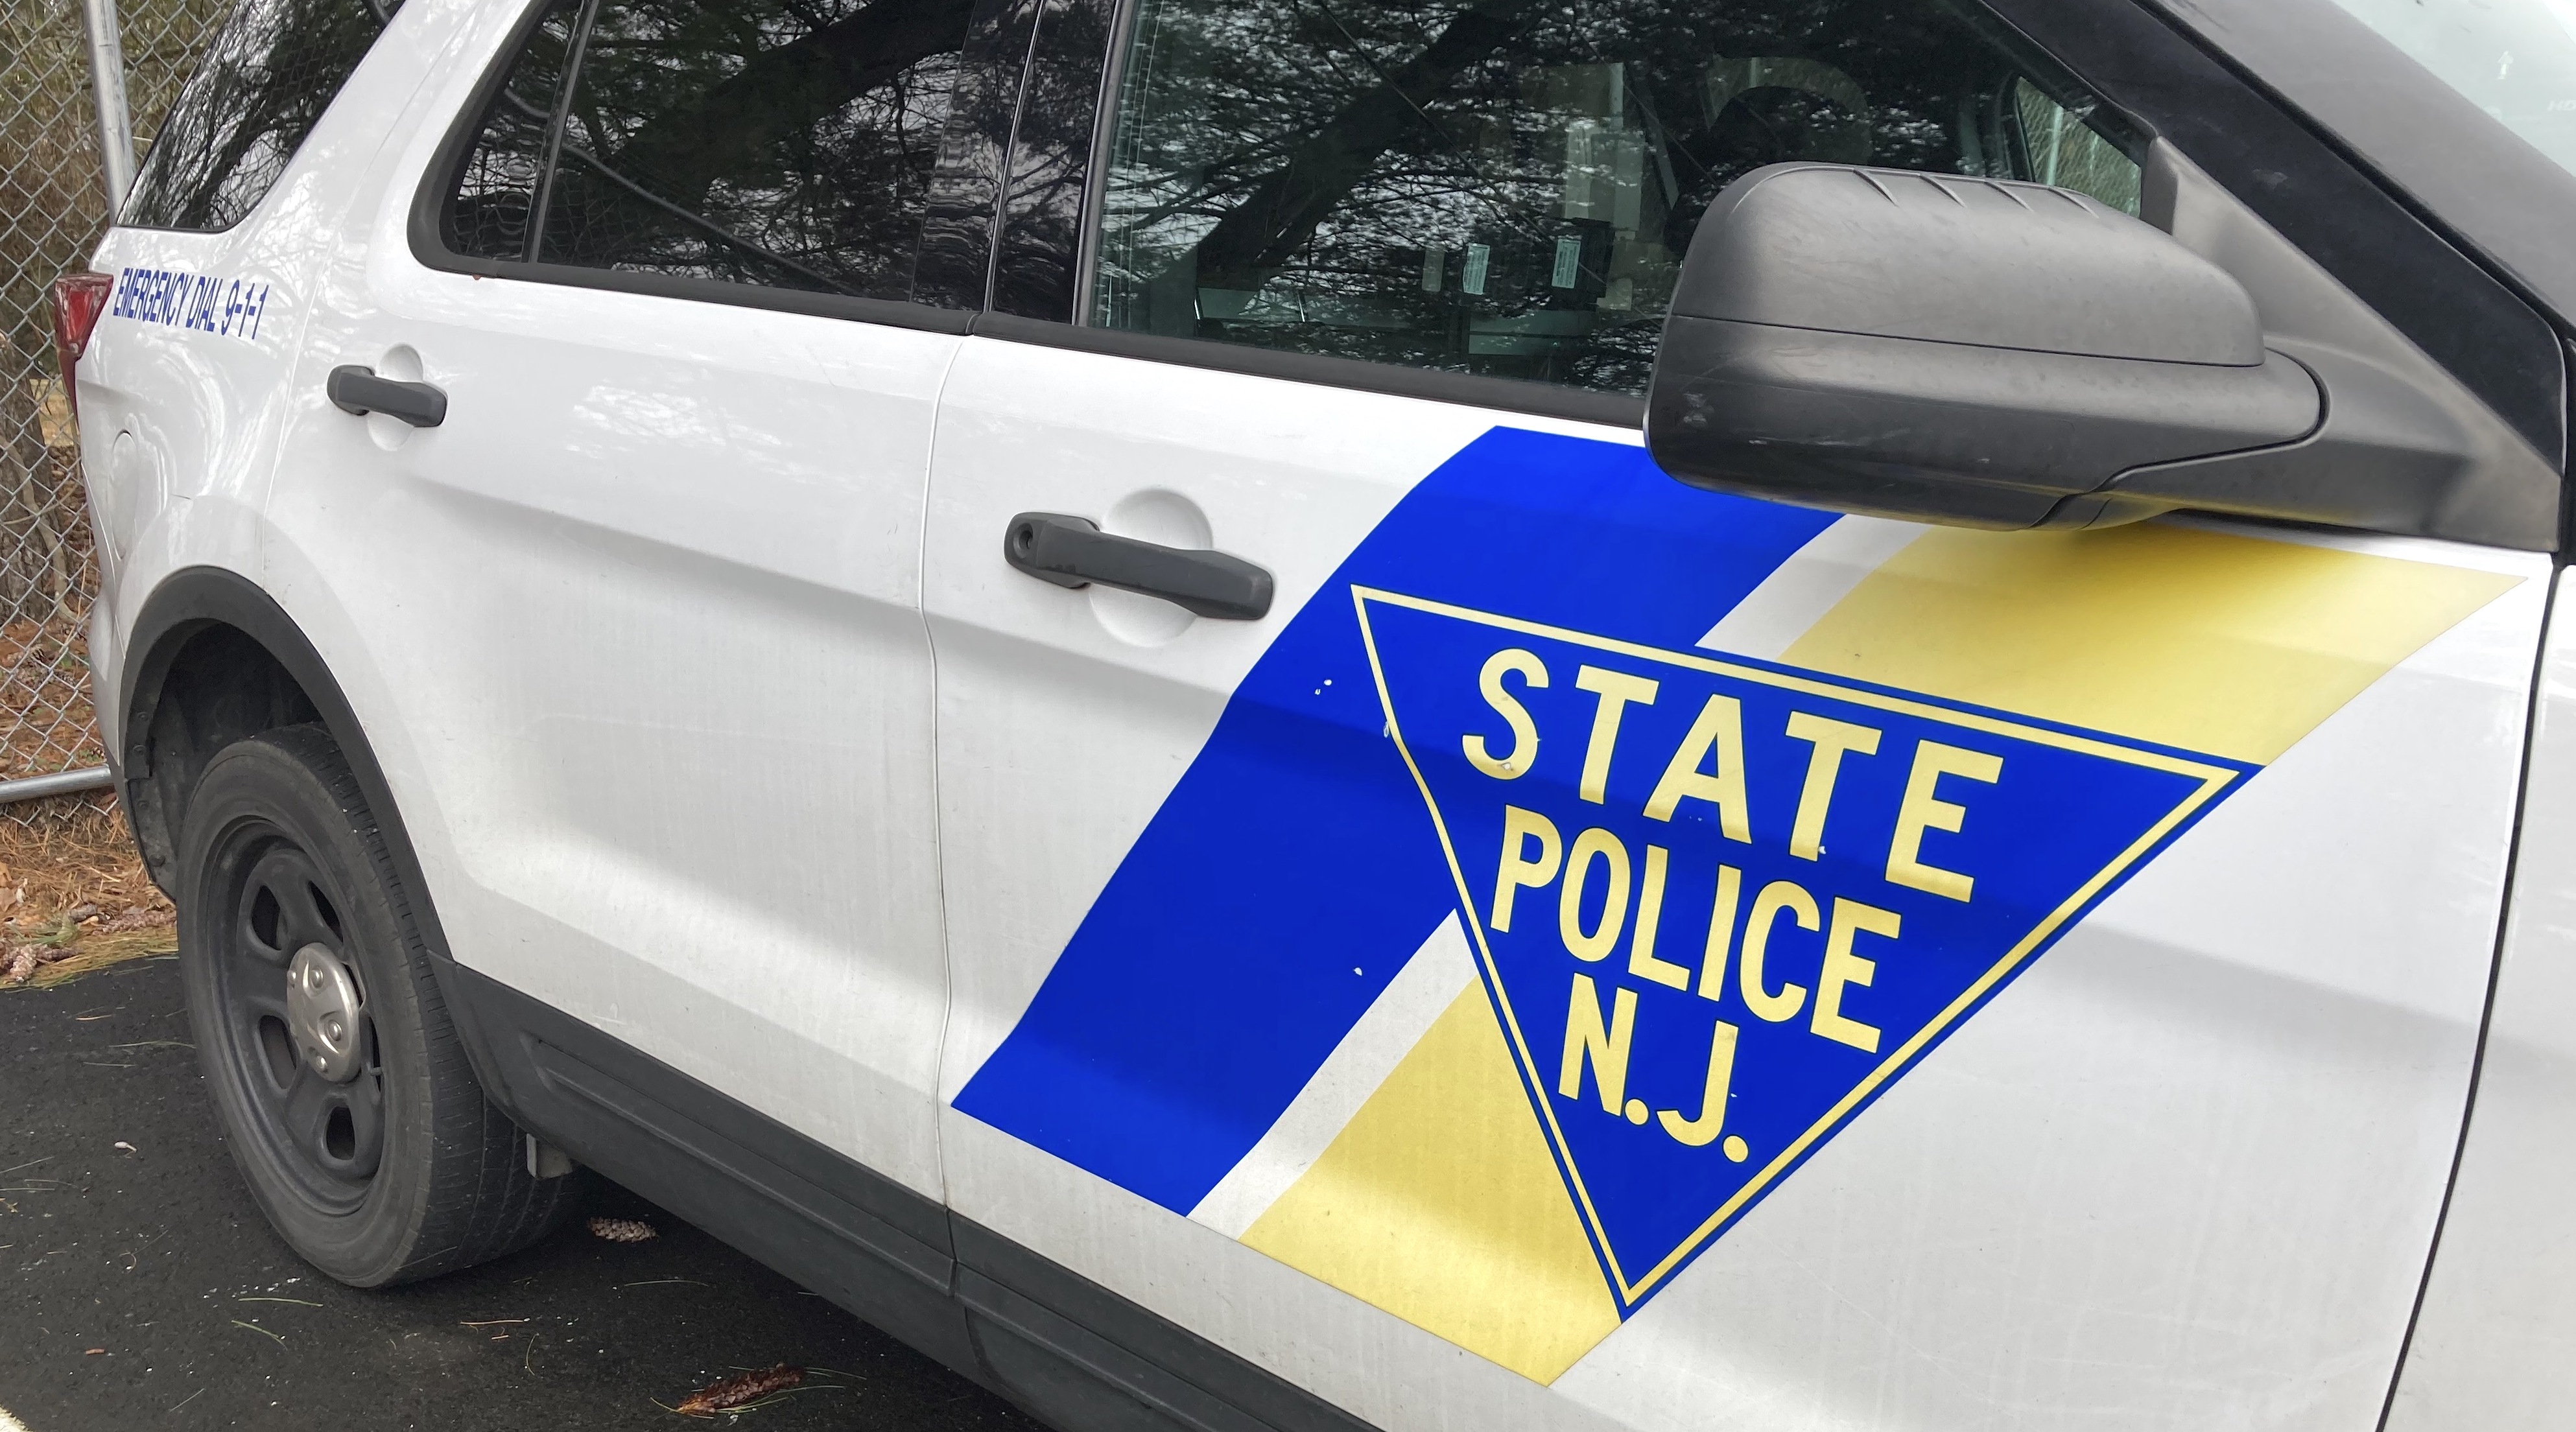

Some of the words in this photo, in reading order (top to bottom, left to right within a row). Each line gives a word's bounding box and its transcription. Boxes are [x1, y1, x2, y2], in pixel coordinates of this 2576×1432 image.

[113, 267, 195, 326] EMERGENCY
[185, 276, 223, 332] DIAL
[220, 279, 269, 340] 9-1-1
[1461, 648, 2004, 903] STATE
[1489, 803, 1902, 1054] POLICE
[1557, 972, 1749, 1164] N.J.
